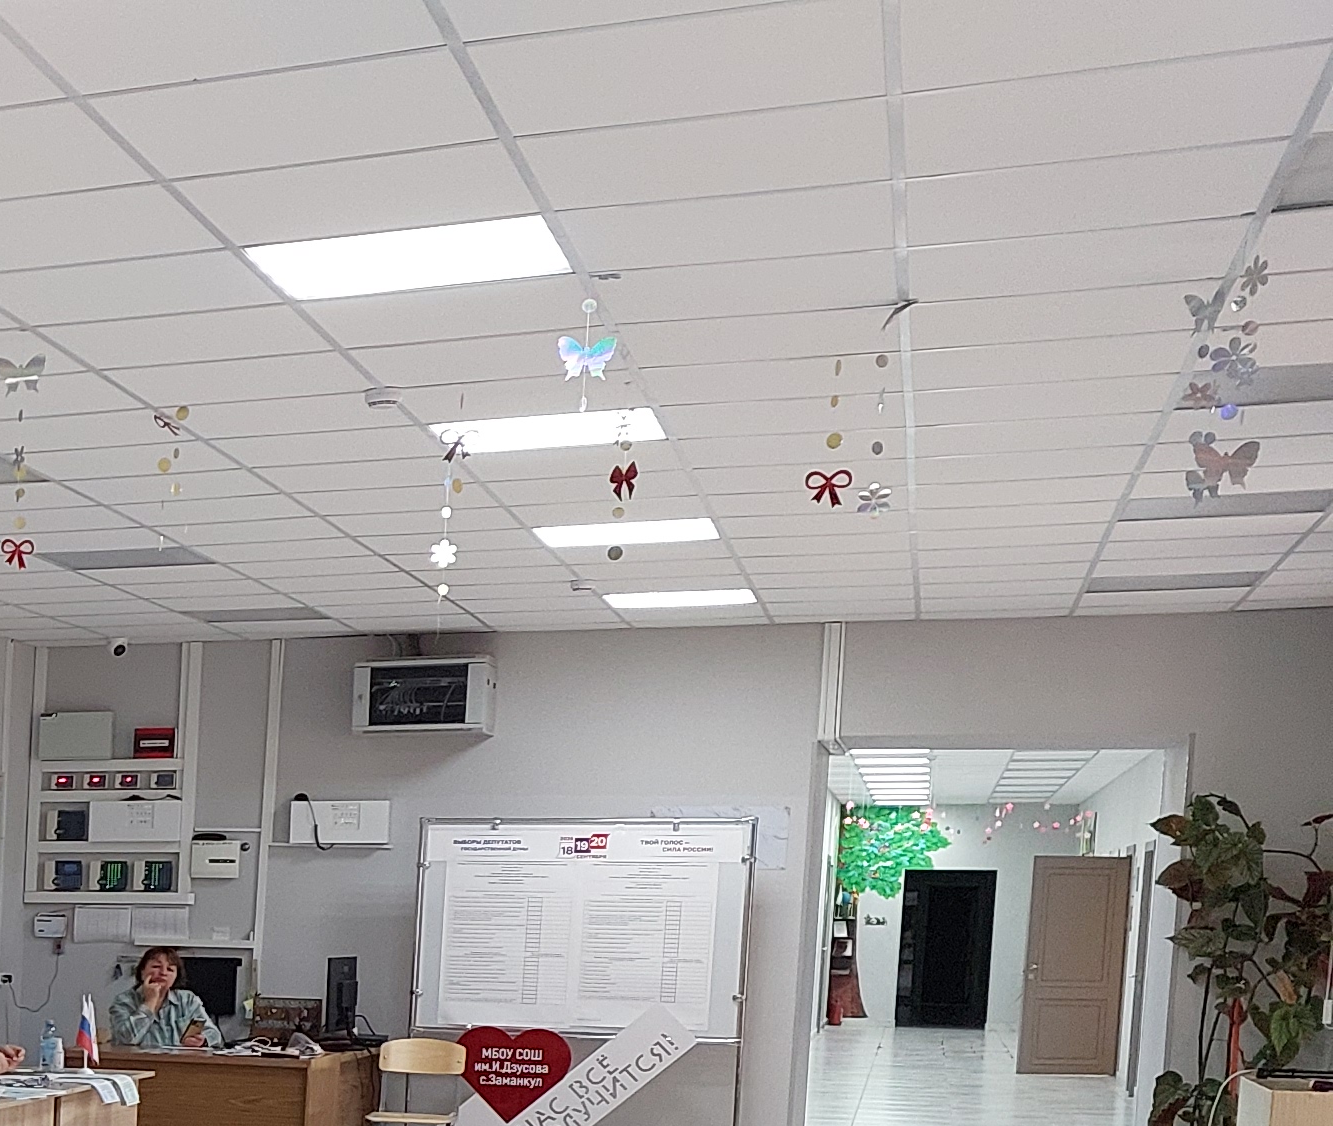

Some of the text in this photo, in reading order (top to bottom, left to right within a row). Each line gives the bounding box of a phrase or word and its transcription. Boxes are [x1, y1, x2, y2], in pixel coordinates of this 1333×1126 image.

[560, 837, 606, 856] 18 19 20
[640, 838, 659, 846] ТВОЙ
[481, 1047, 543, 1061] МБОУ СОШ
[568, 1054, 620, 1100] ВСЁ
